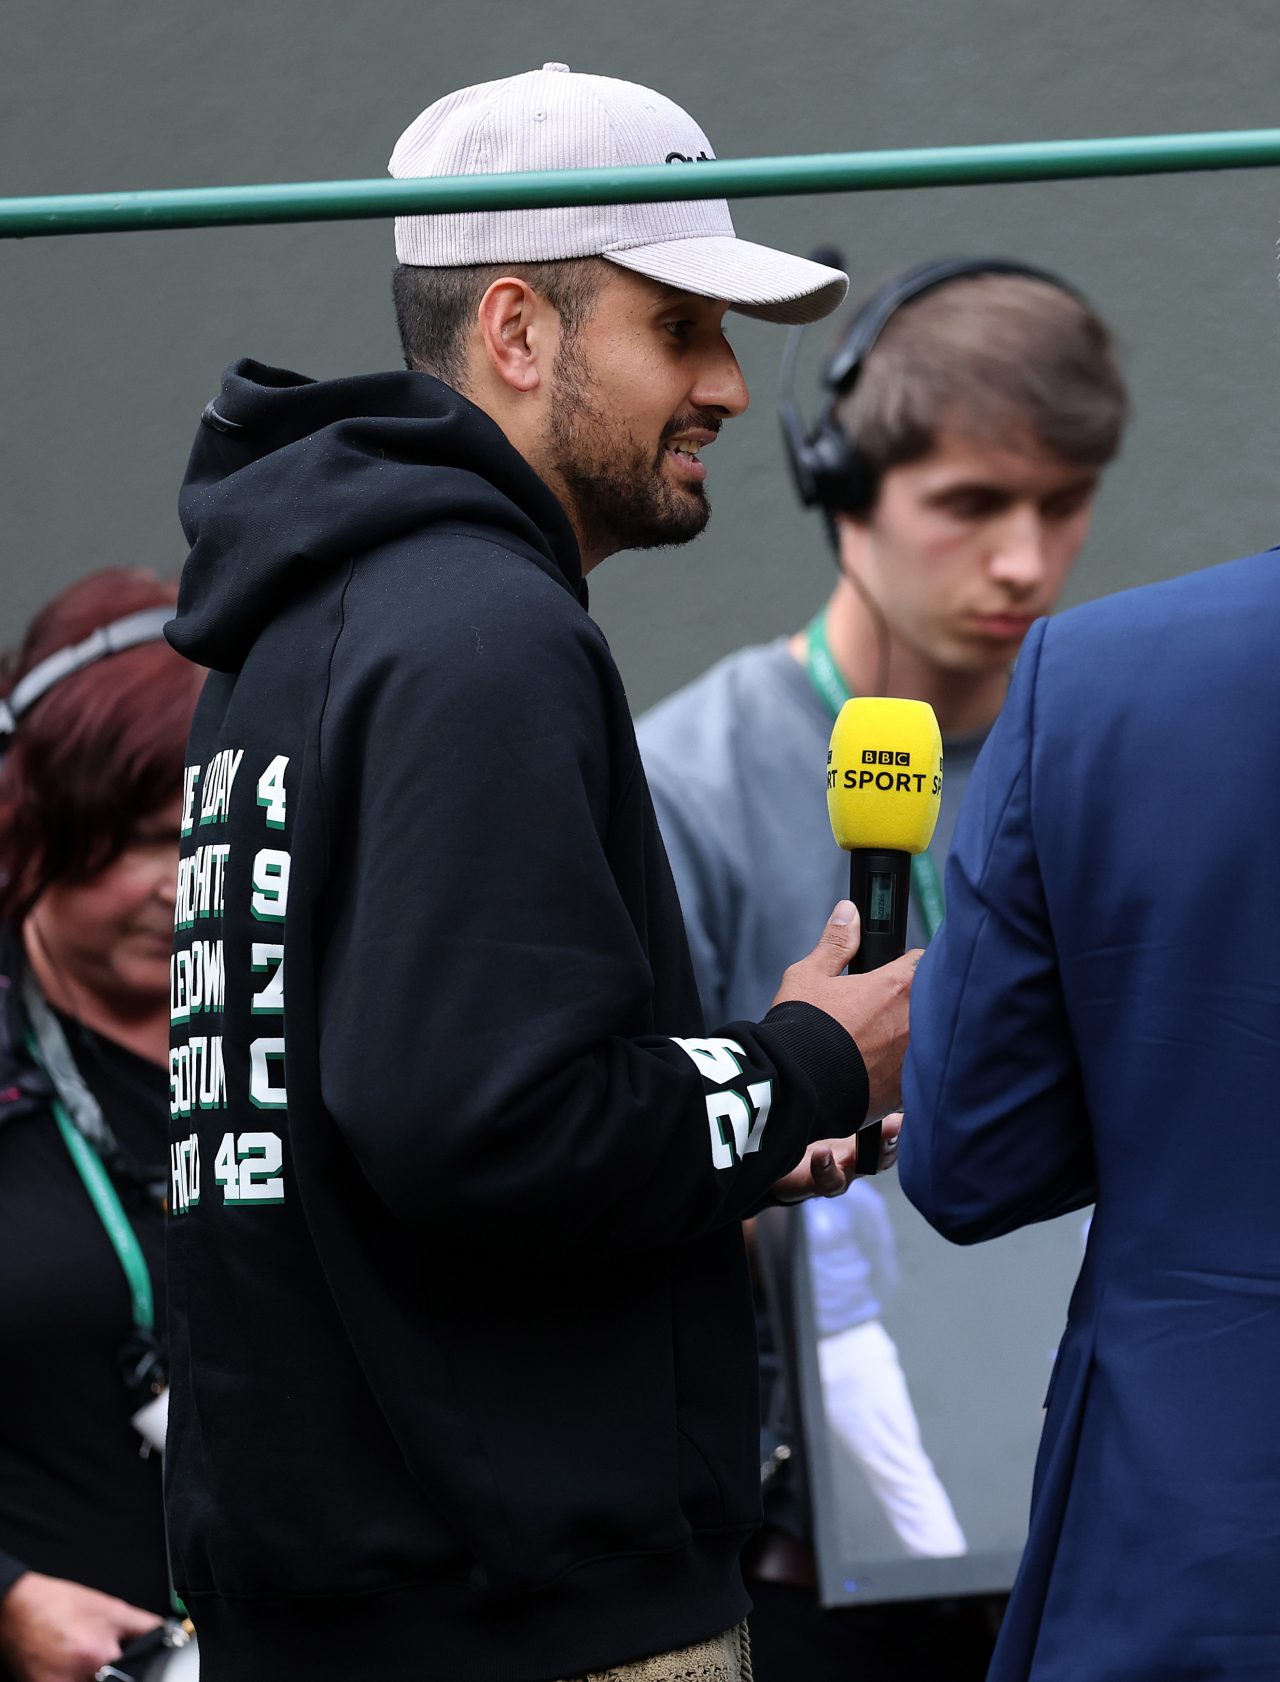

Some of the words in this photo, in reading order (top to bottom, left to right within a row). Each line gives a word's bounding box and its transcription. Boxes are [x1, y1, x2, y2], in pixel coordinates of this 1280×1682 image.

[256, 754, 290, 831] 4
[843, 769, 927, 793] SPORT
[861, 750, 911, 767] BBC
[250, 848, 292, 924] 9
[214, 1131, 286, 1206] 42
